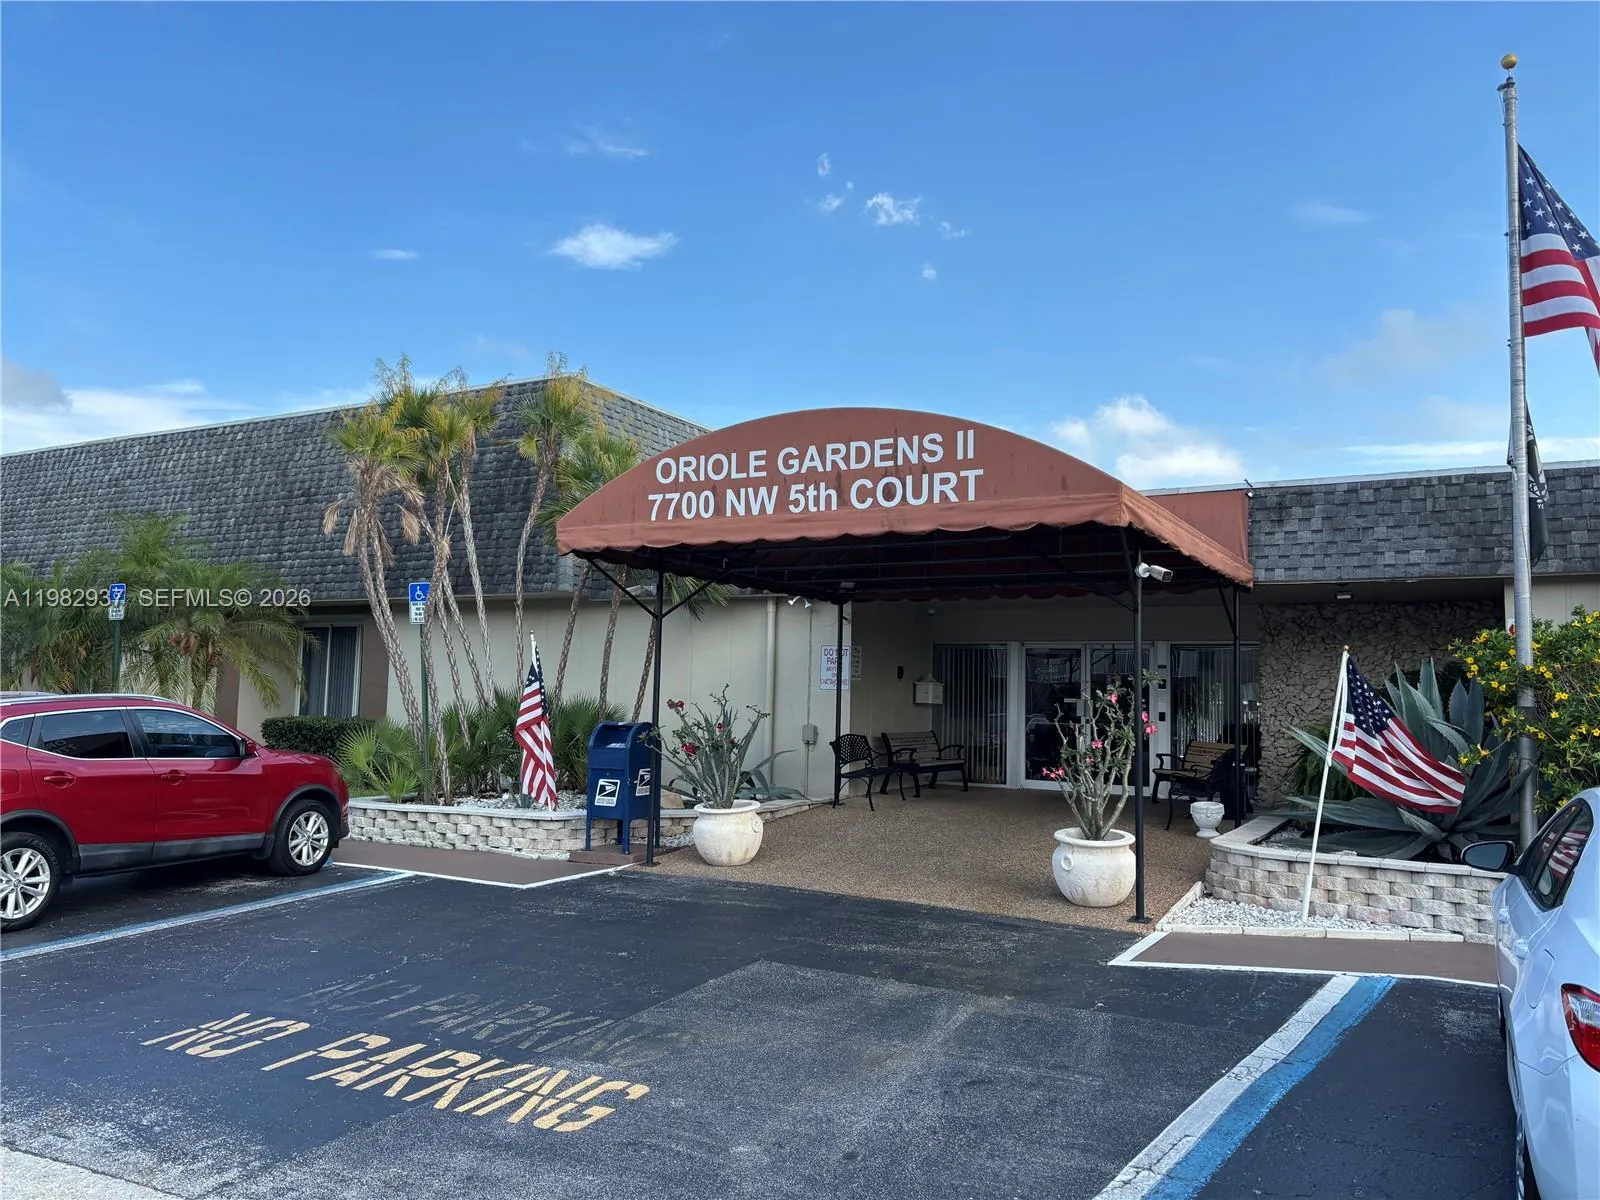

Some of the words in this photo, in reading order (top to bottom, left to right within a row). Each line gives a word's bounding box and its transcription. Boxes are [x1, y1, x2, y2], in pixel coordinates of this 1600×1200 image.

[656, 450, 767, 485] ORIOLE
[777, 433, 944, 475] GARDENS
[956, 429, 975, 461] II
[648, 489, 715, 521] 7700
[726, 485, 779, 517] NW
[788, 481, 838, 514] 5th
[850, 468, 984, 510] COURT
[823, 648, 834, 656] DO
[826, 657, 841, 665] PAR
[141, 1012, 310, 1058] NO
[261, 1032, 650, 1133] PARKING
